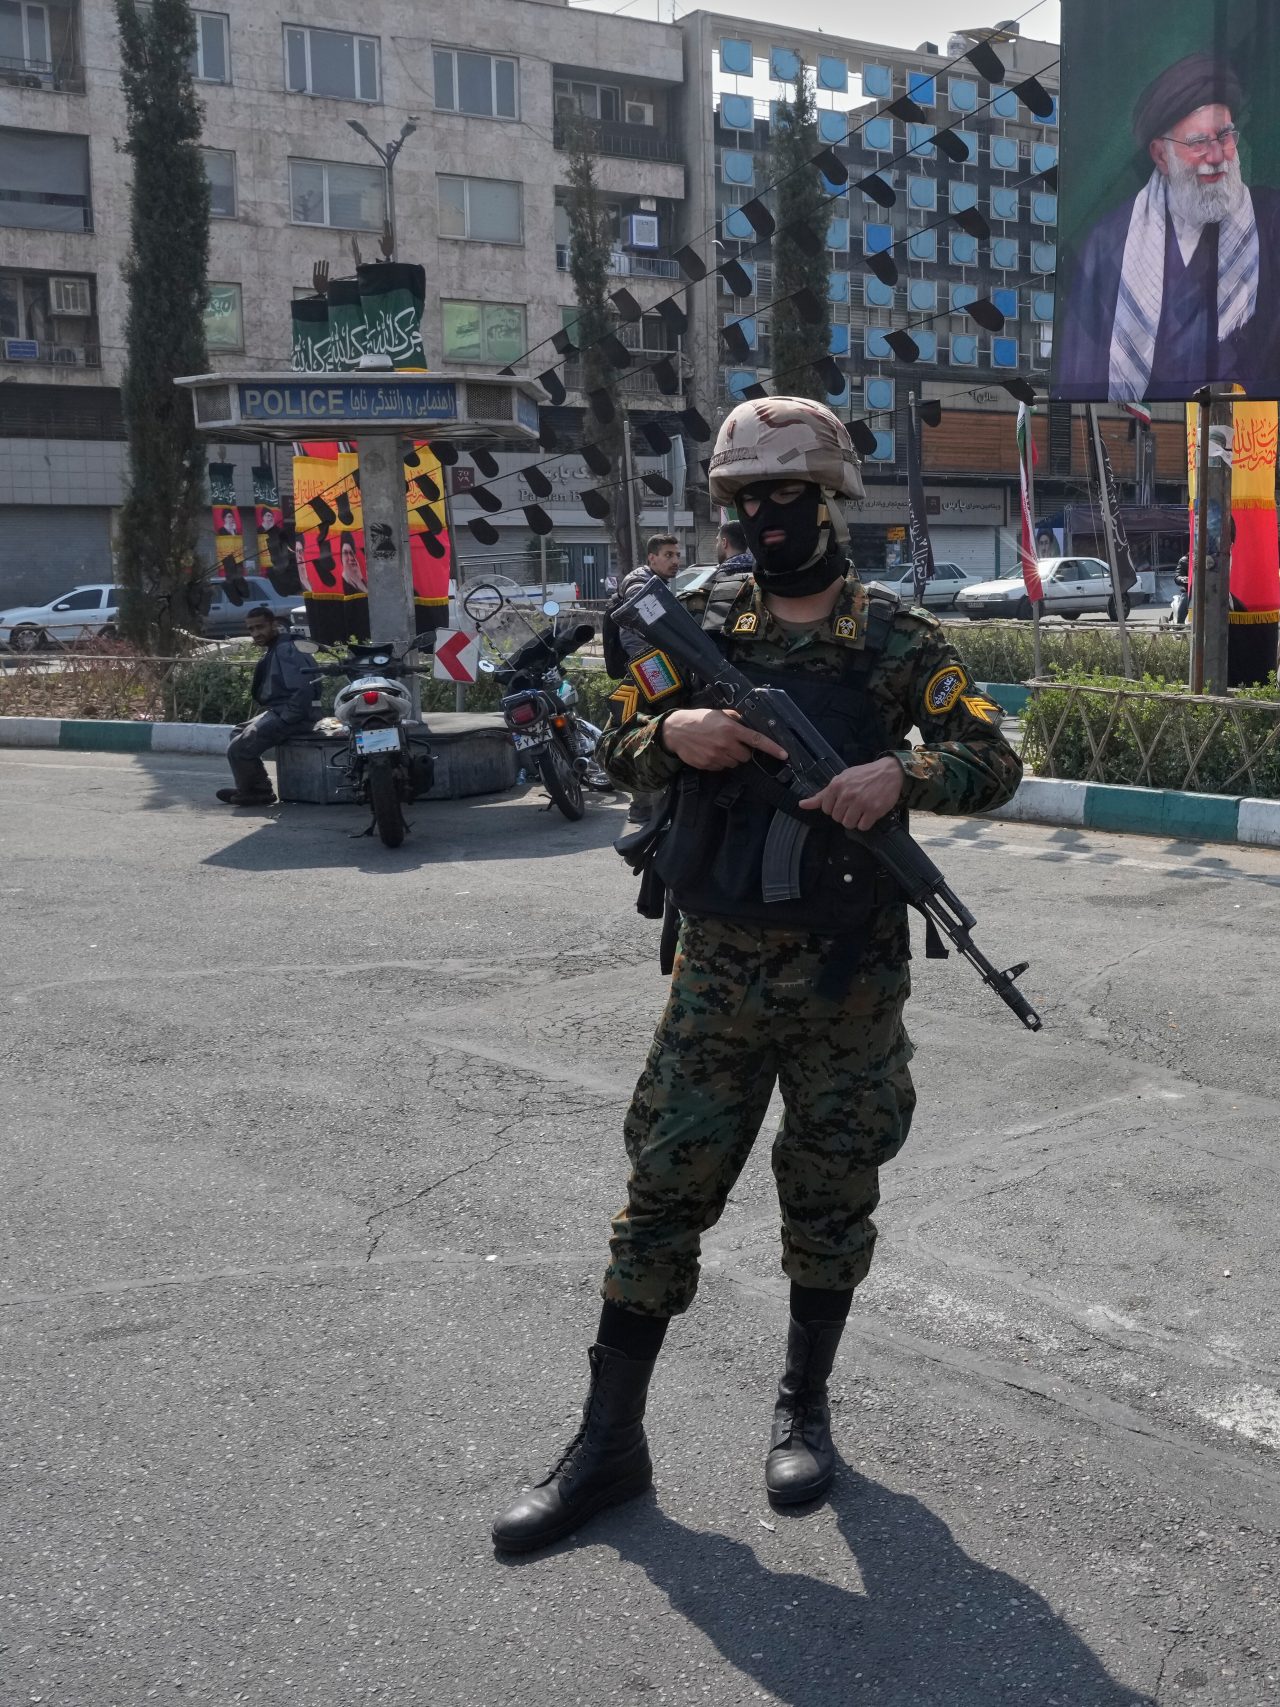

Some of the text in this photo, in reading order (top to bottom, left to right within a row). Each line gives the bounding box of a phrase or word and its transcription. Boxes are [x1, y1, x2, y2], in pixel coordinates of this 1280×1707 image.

[244, 389, 345, 415] POLICE
[350, 388, 455, 416] راهنمایی و رانندگی ناجا
